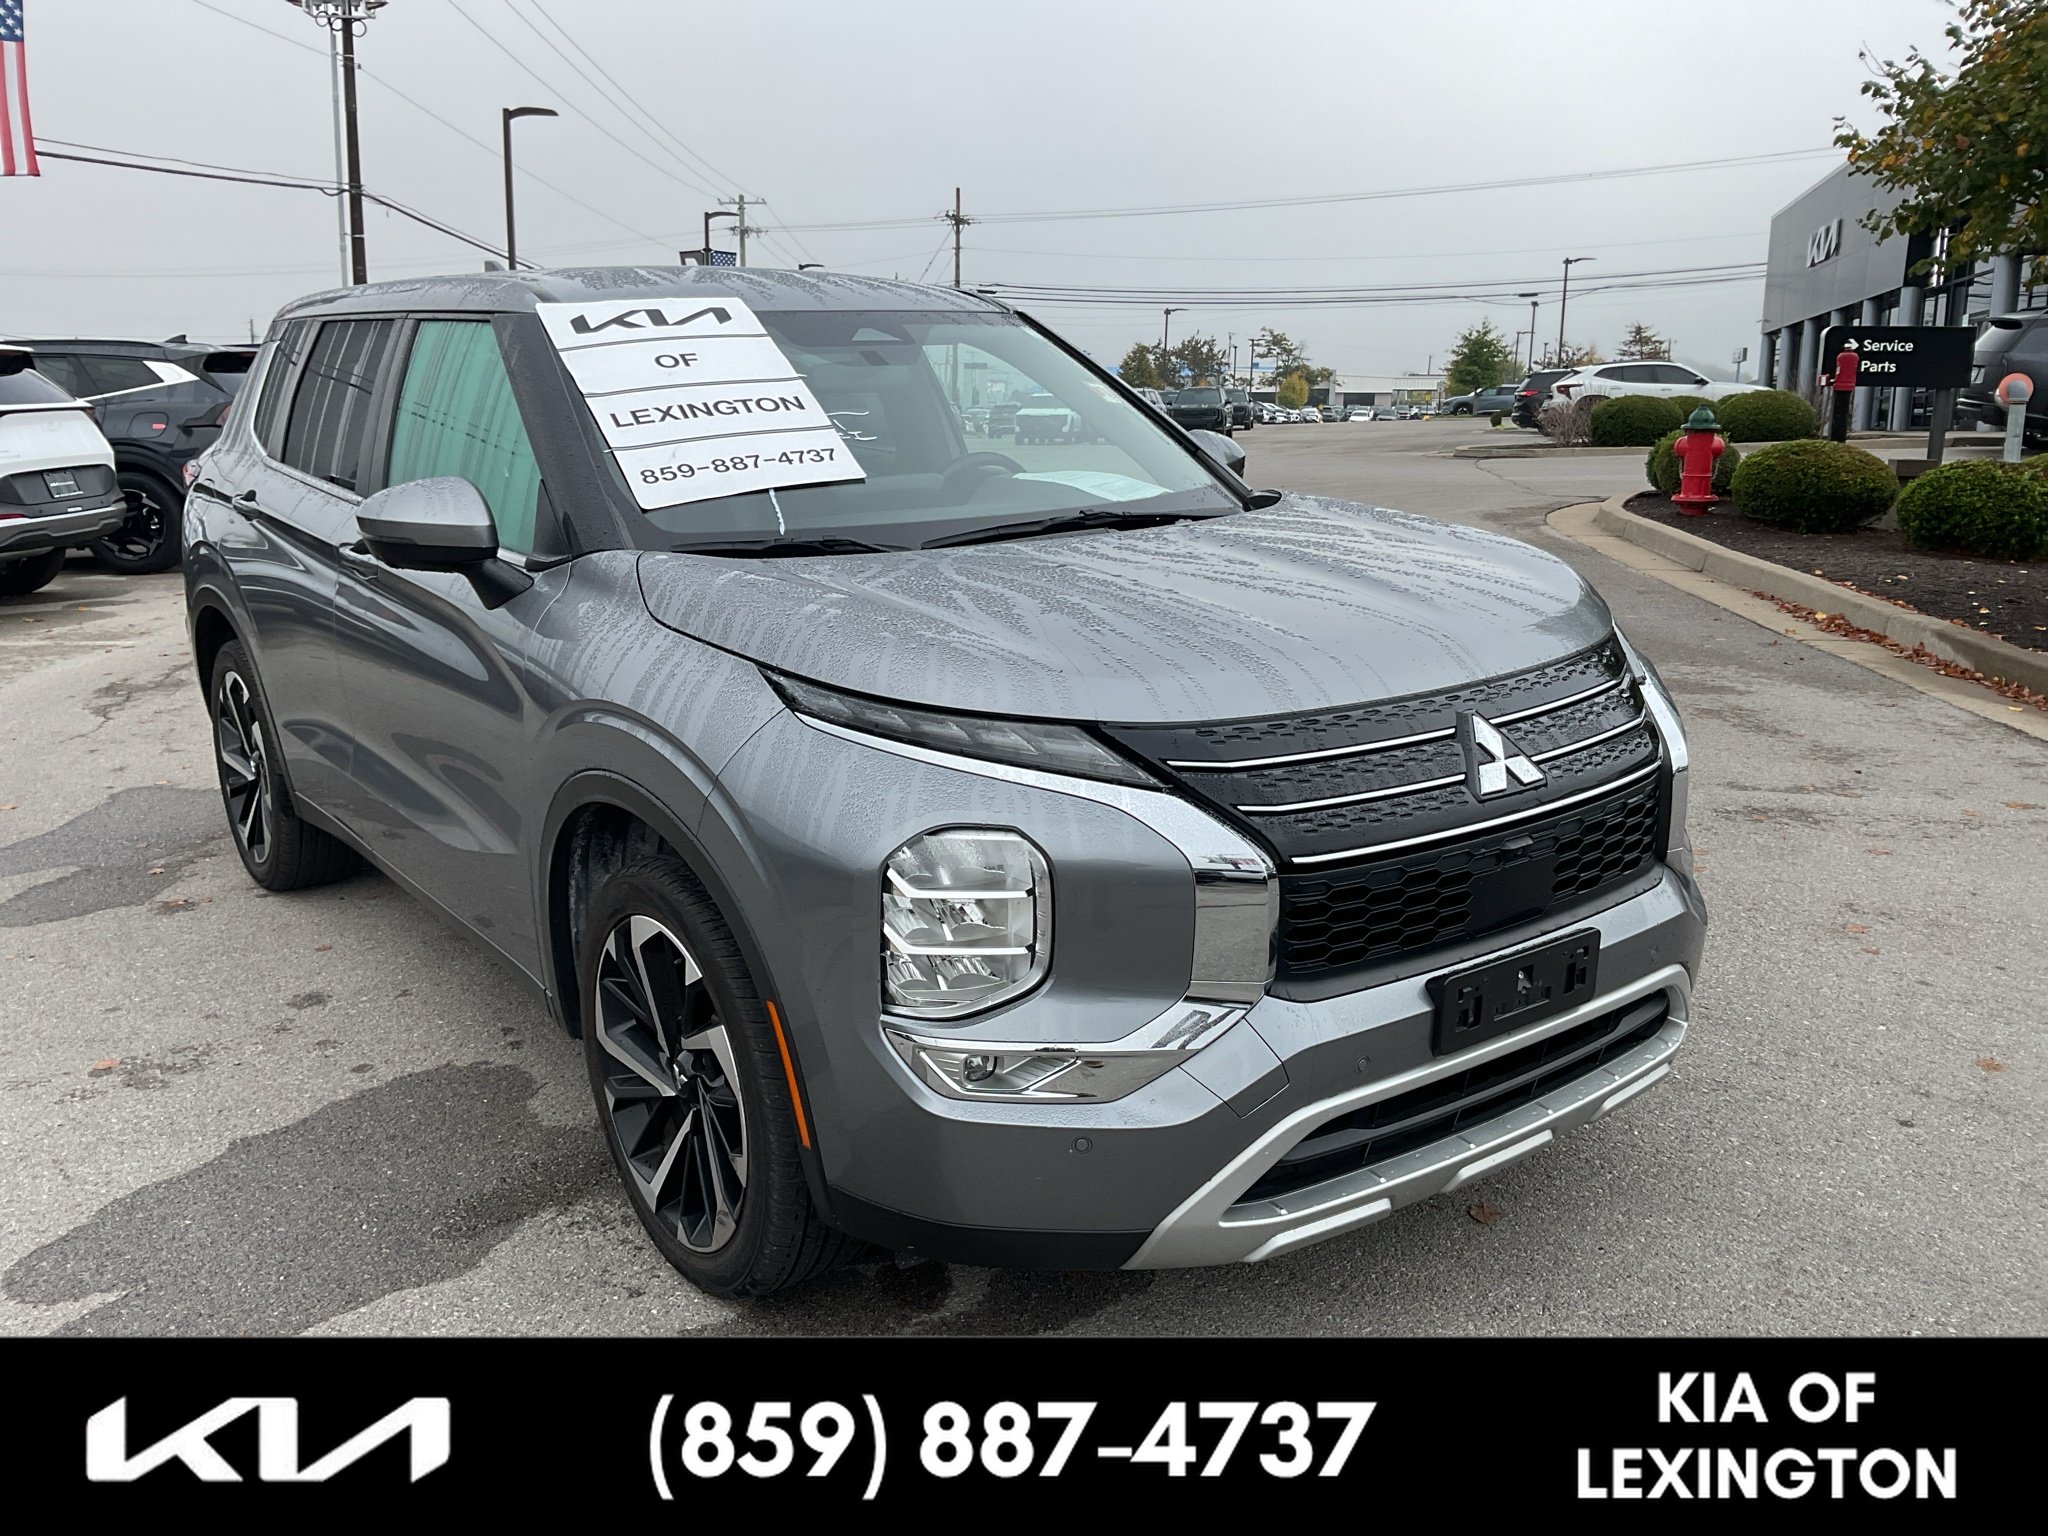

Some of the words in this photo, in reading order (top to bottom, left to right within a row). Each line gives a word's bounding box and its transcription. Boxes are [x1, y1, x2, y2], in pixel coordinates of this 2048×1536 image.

[1863, 340, 1914, 352] Service
[655, 353, 698, 369] OF
[1860, 360, 1897, 373] Parts
[610, 396, 806, 428] LEXINGTON
[640, 448, 836, 484] 859-887-4737
